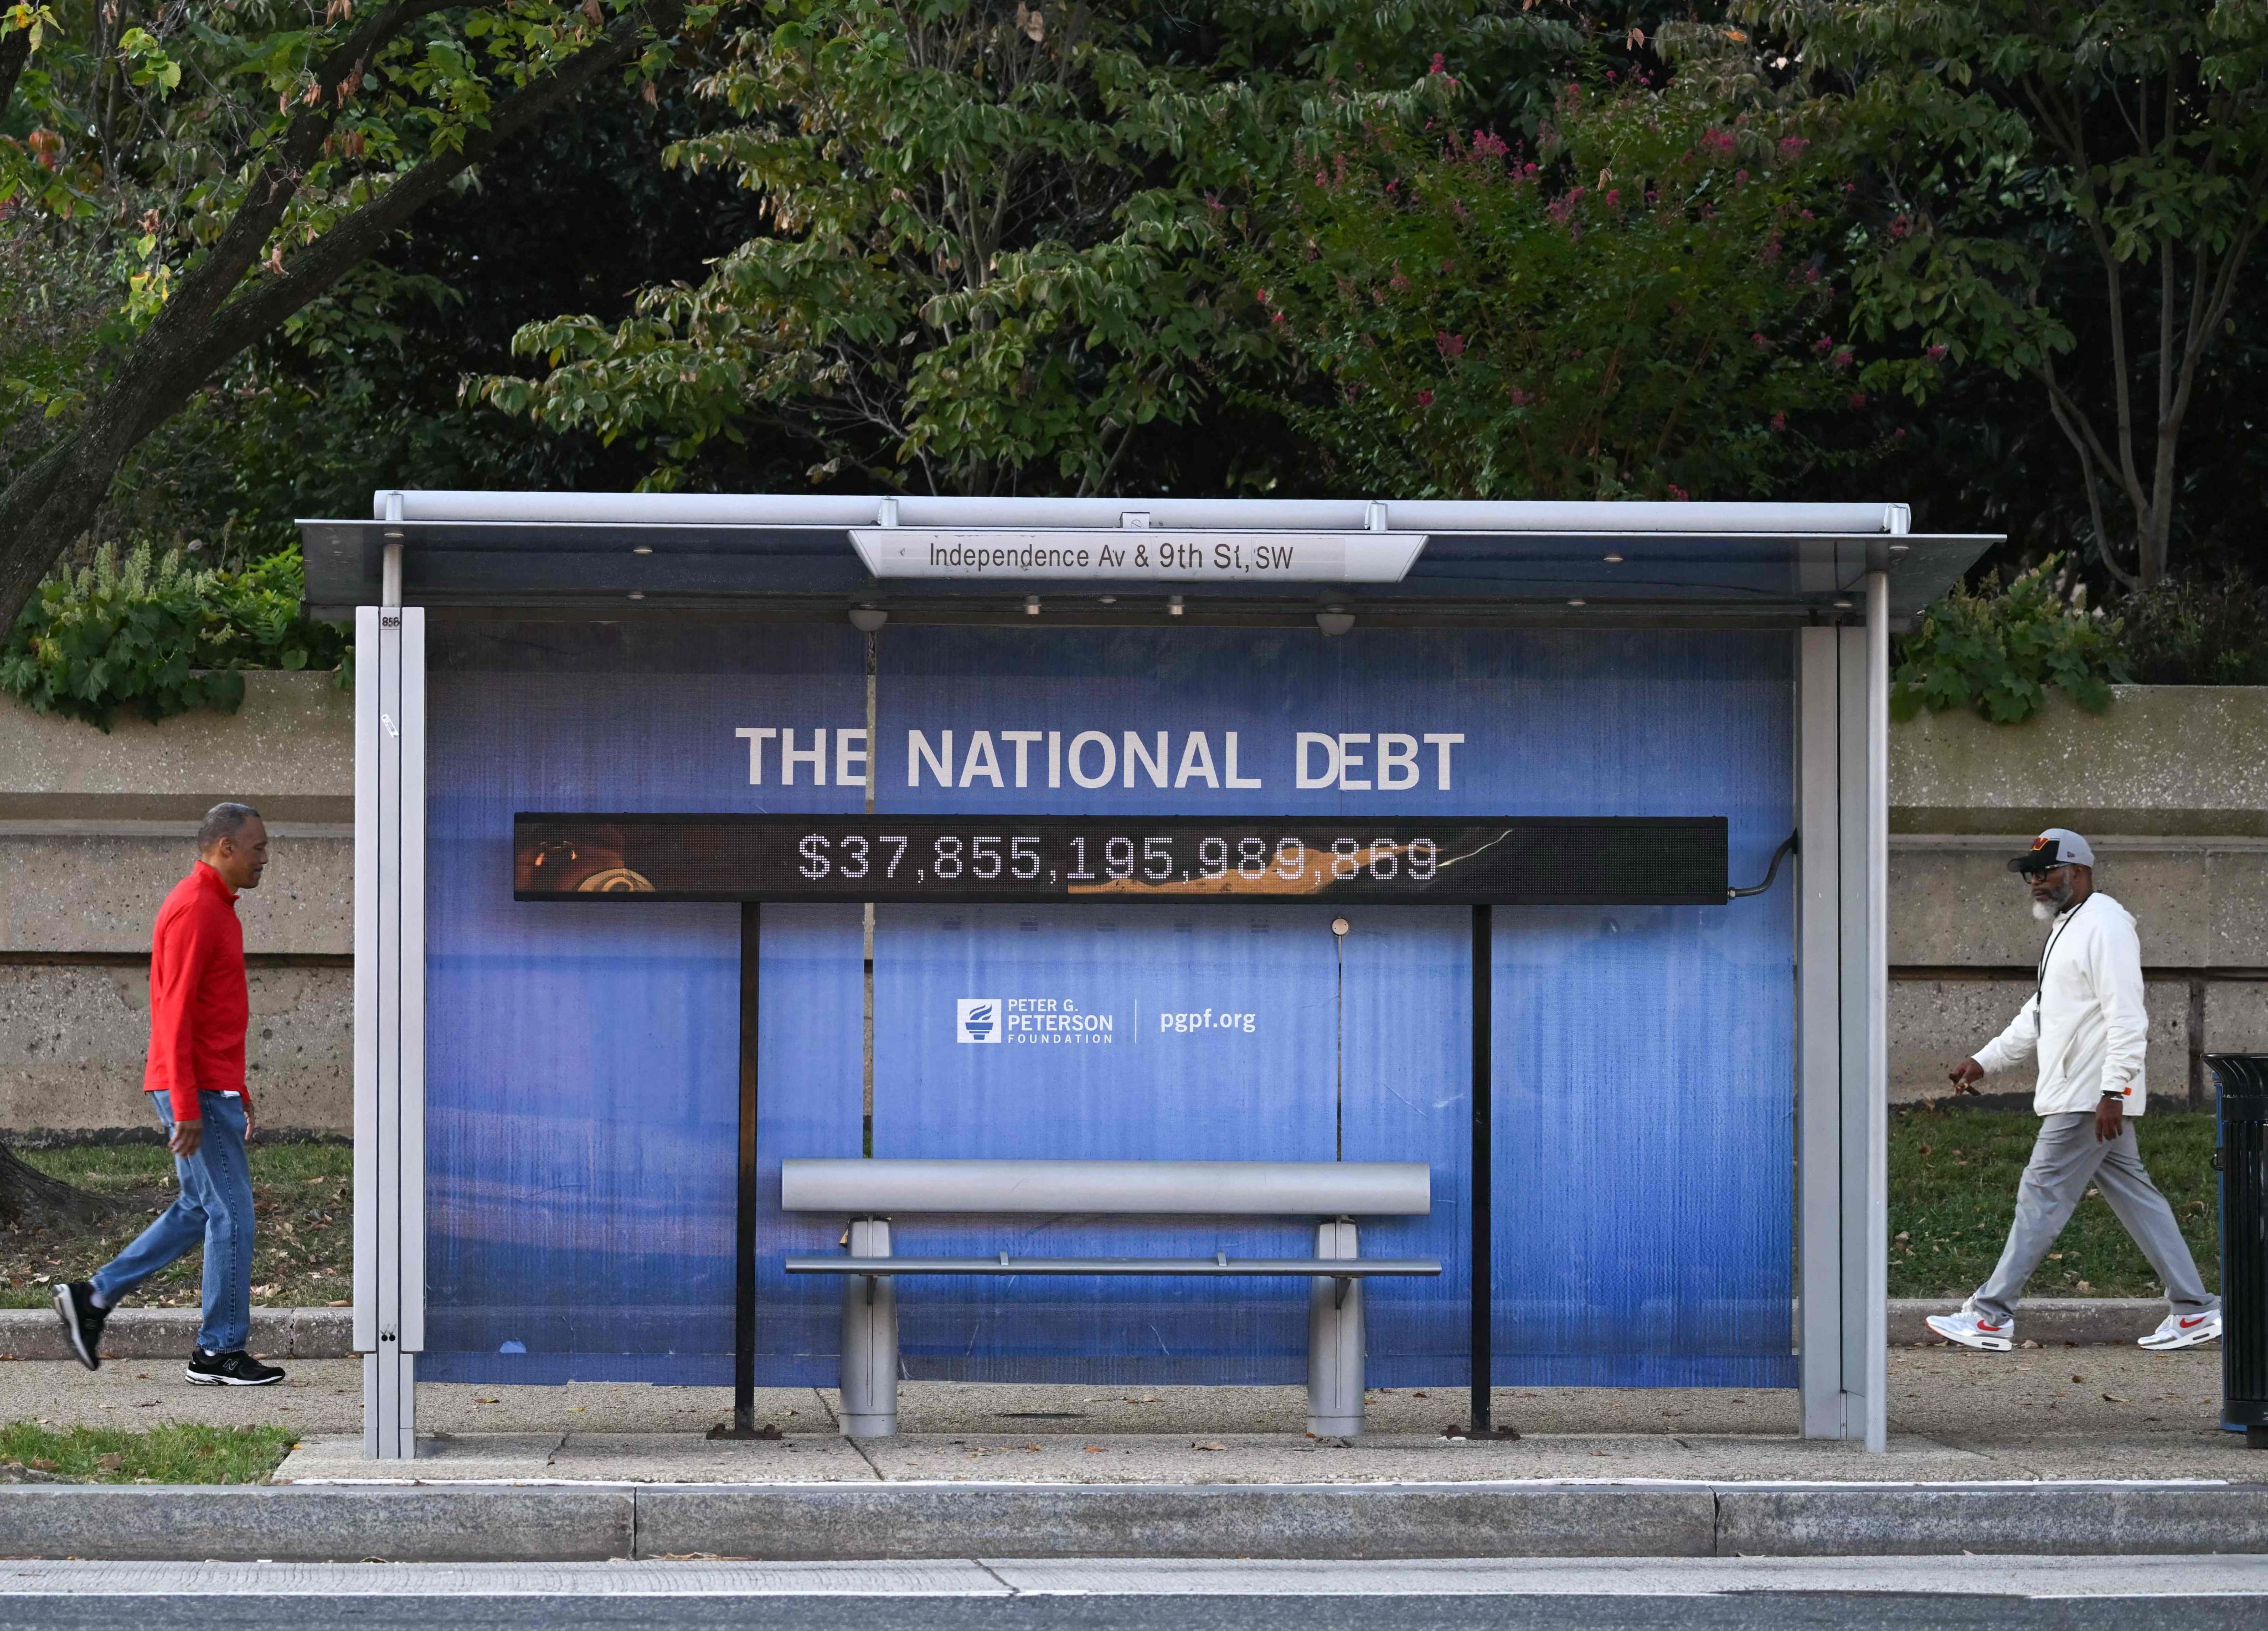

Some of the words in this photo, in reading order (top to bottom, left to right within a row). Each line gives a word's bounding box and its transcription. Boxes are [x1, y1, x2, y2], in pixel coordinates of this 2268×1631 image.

[930, 543, 1089, 572] Independence
[1098, 544, 1125, 567] Av
[1135, 544, 1149, 567] &
[1159, 543, 1202, 568] 9th
[382, 617, 400, 627] 858
[735, 727, 867, 786] THE
[908, 730, 1262, 789] NATIONAL
[1296, 732, 1465, 791] DEBT
[799, 833, 1436, 885] $37,855,195,989,869
[1008, 999, 1057, 1012] PETER
[1063, 999, 1079, 1012] G.
[1008, 1014, 1113, 1031] PETERSON
[1161, 1008, 1256, 1033] pgpf.org
[1008, 1034, 1112, 1044] FOUNDATION
